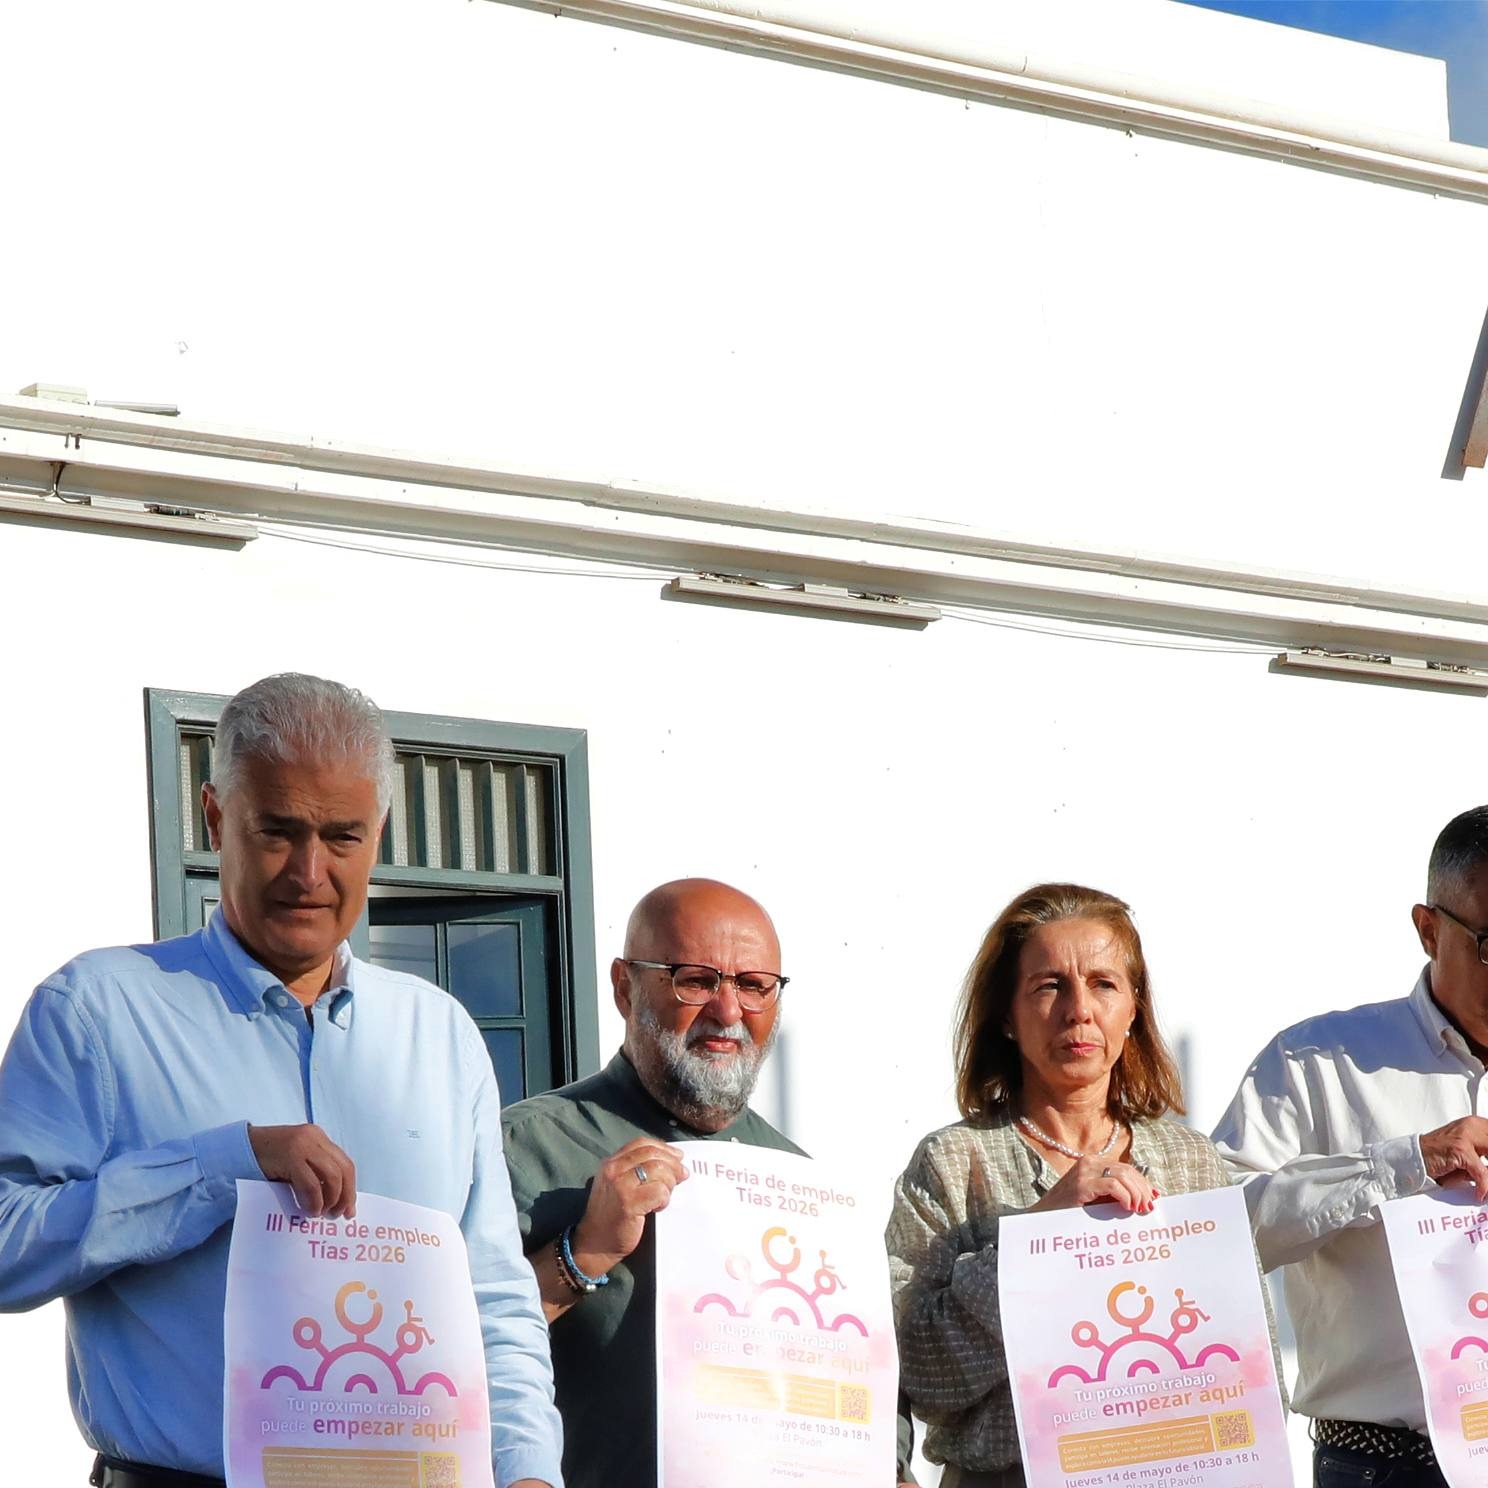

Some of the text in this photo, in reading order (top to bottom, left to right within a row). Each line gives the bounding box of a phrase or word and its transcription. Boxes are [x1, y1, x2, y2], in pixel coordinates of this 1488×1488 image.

[692, 1160, 856, 1208] III Feria de empleo
[777, 1195, 819, 1217] 2026
[266, 1213, 440, 1247] III Feria de empleo
[1418, 1219, 1435, 1235] III
[1441, 1211, 1488, 1231] Feria
[1030, 1219, 1216, 1255] III Feria de empleo
[308, 1240, 406, 1264] Tías 2026
[1074, 1244, 1171, 1270] Tías 2026
[1074, 1373, 1216, 1404] Tu trabajo
[288, 1398, 431, 1419] Tu próximo trabajo
[1053, 1380, 1245, 1427] puede empezar aquí
[262, 1418, 457, 1442] puede empezar aquí
[1106, 1473, 1120, 1484] 14
[1123, 1471, 1137, 1481] de
[1140, 1466, 1172, 1479] mayo
[1175, 1462, 1190, 1474] de
[1193, 1458, 1222, 1471] 10:30
[1225, 1458, 1233, 1466] a
[1236, 1454, 1248, 1464] 18
[1251, 1452, 1260, 1462] h
[1170, 1474, 1204, 1487] Pavón
